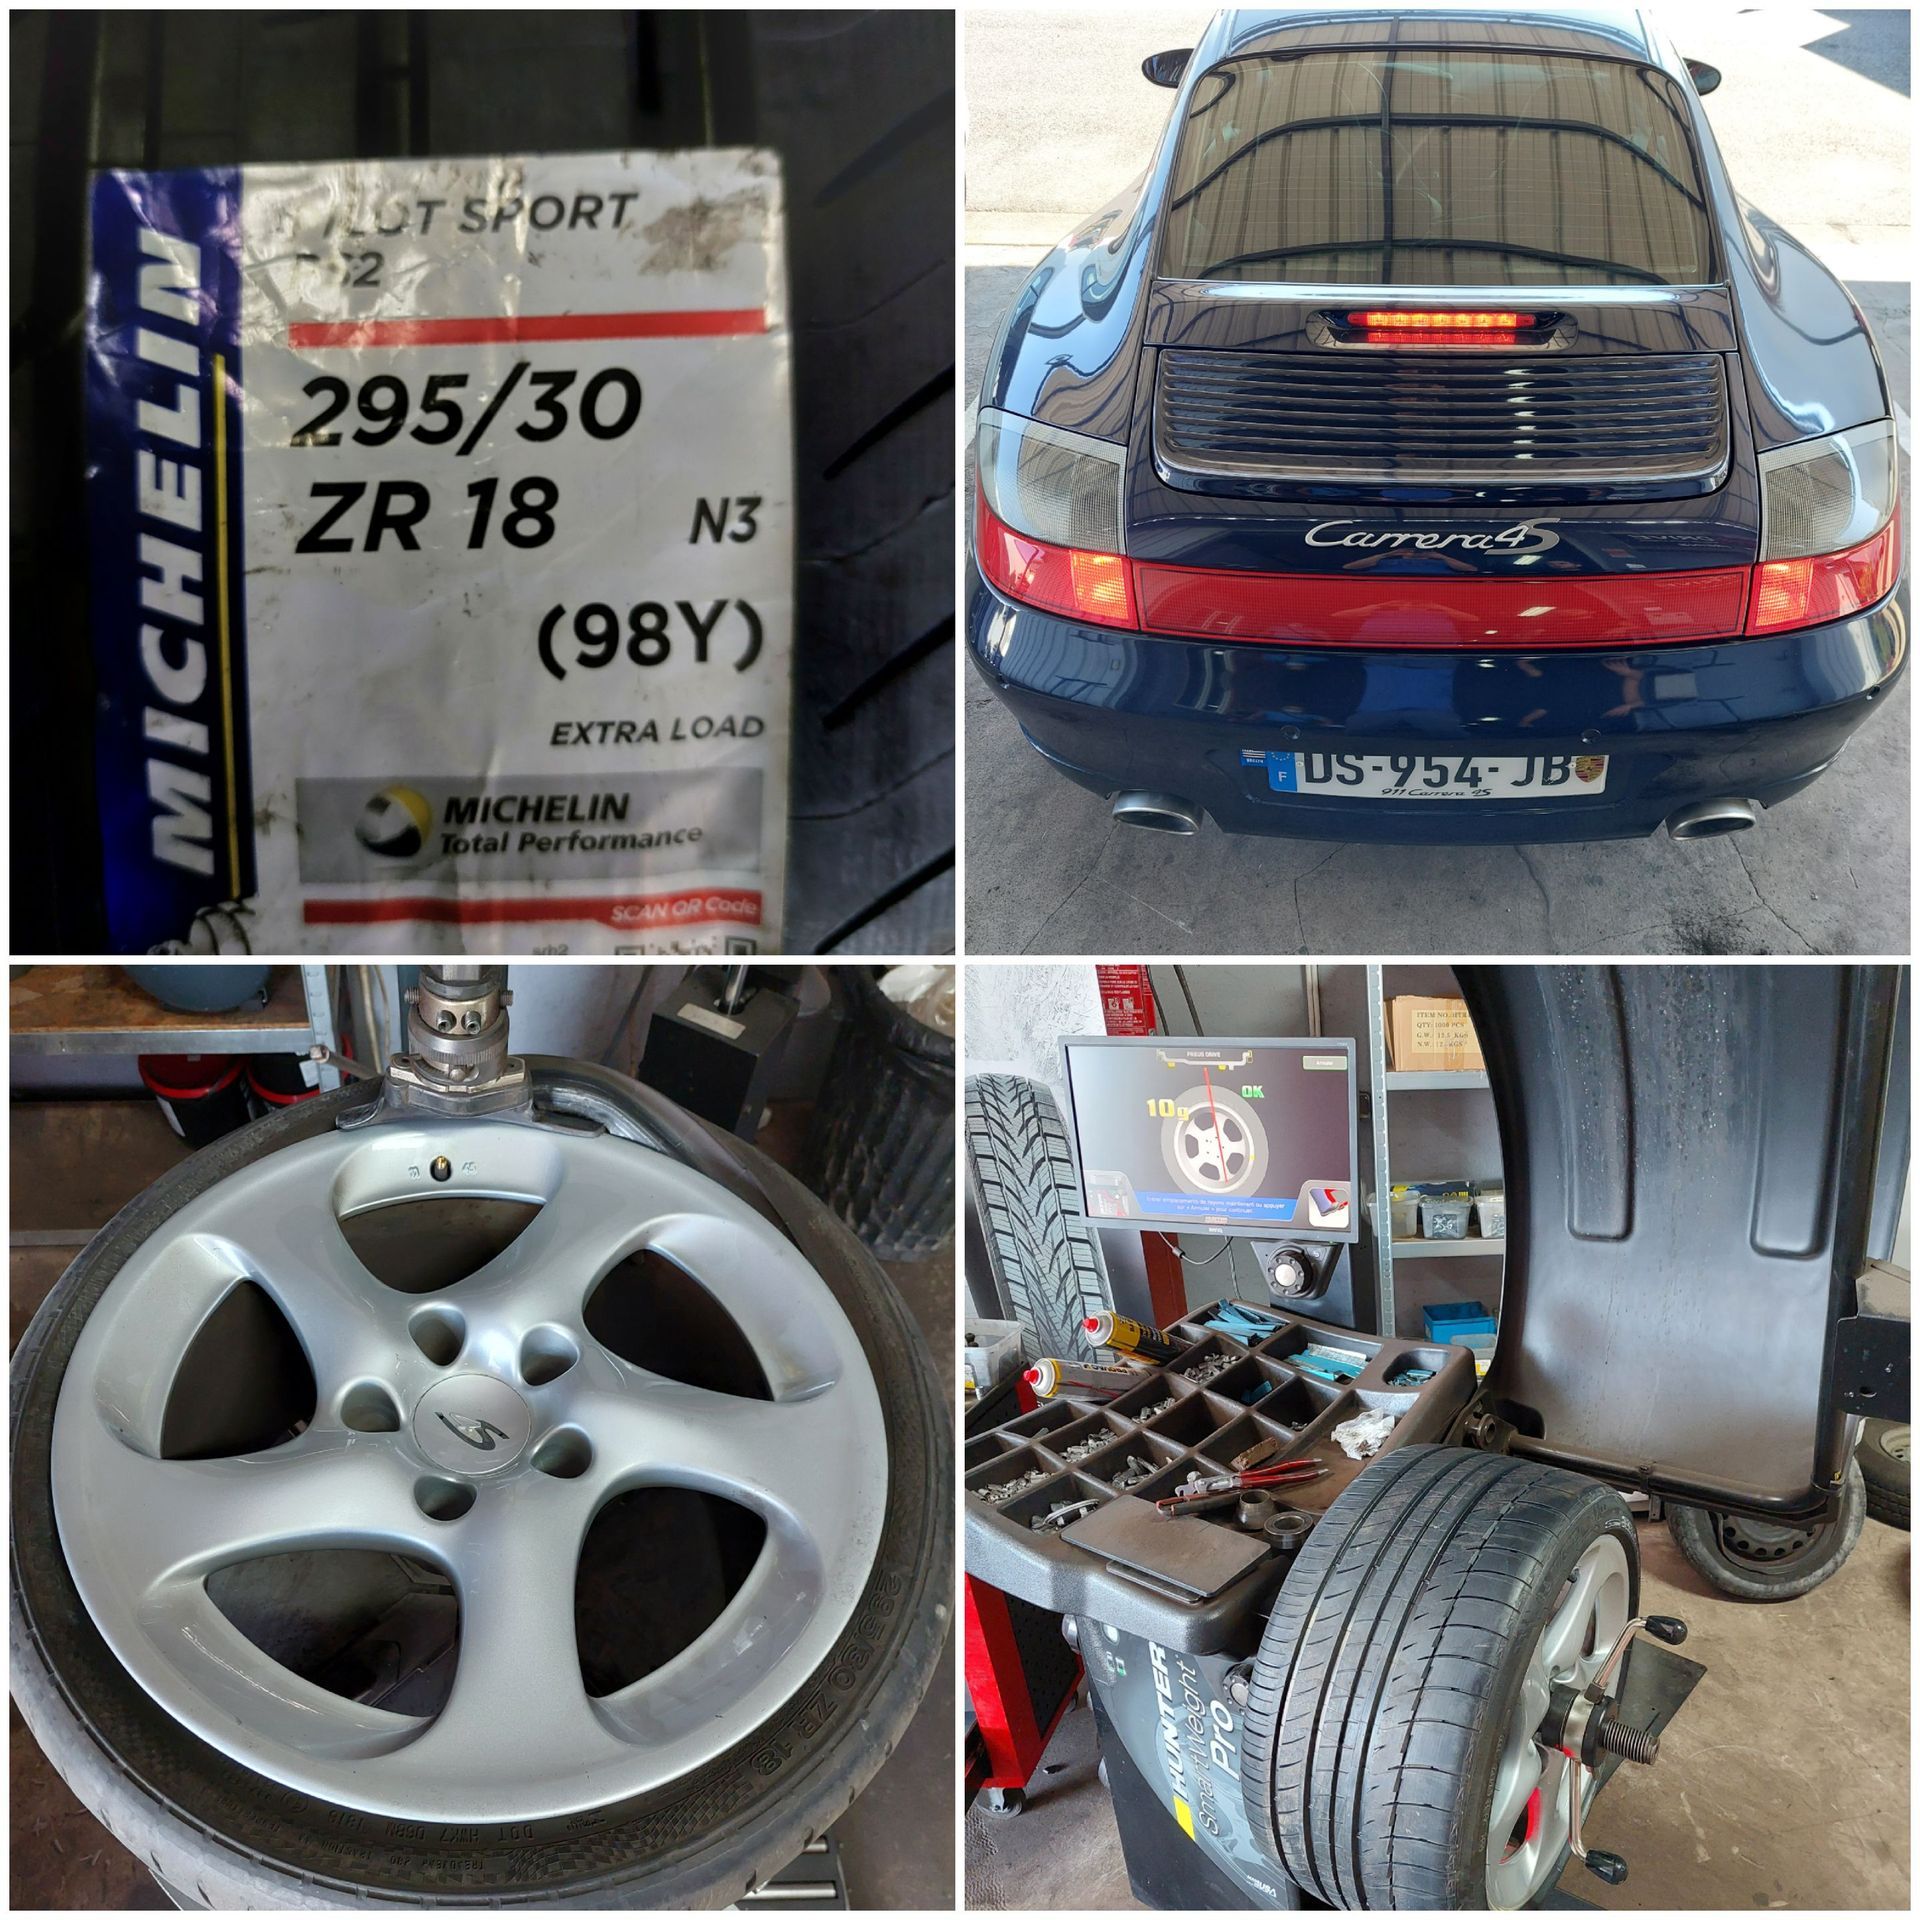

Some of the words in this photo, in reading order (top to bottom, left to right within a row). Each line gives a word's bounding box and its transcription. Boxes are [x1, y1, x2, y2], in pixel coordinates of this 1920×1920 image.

[287, 198, 447, 239] ILOT
[457, 192, 639, 235] SPORT
[289, 362, 643, 456] 295/30
[295, 481, 431, 554] ZR
[465, 475, 561, 550] 18
[689, 496, 765, 545] N3
[1305, 520, 1495, 550] Carrera
[138, 232, 217, 877] MICHELIN
[537, 600, 765, 681] (98Y)
[549, 718, 661, 748] EXTRA
[671, 714, 766, 742] LOAD
[1278, 771, 1288, 784] F
[1381, 788, 1407, 796] 911
[1408, 788, 1466, 797] Carrera
[443, 792, 631, 825] MICHELIN
[440, 831, 509, 855] Total
[518, 825, 703, 853] Performance
[611, 904, 669, 923] SCAN
[672, 899, 702, 917] QR
[706, 896, 758, 915] Code
[1241, 1084, 1265, 1098] OK
[1148, 1641, 1189, 1801] HUNTER
[1210, 1700, 1241, 1782] Pro
[498, 1824, 533, 1842] DOT
